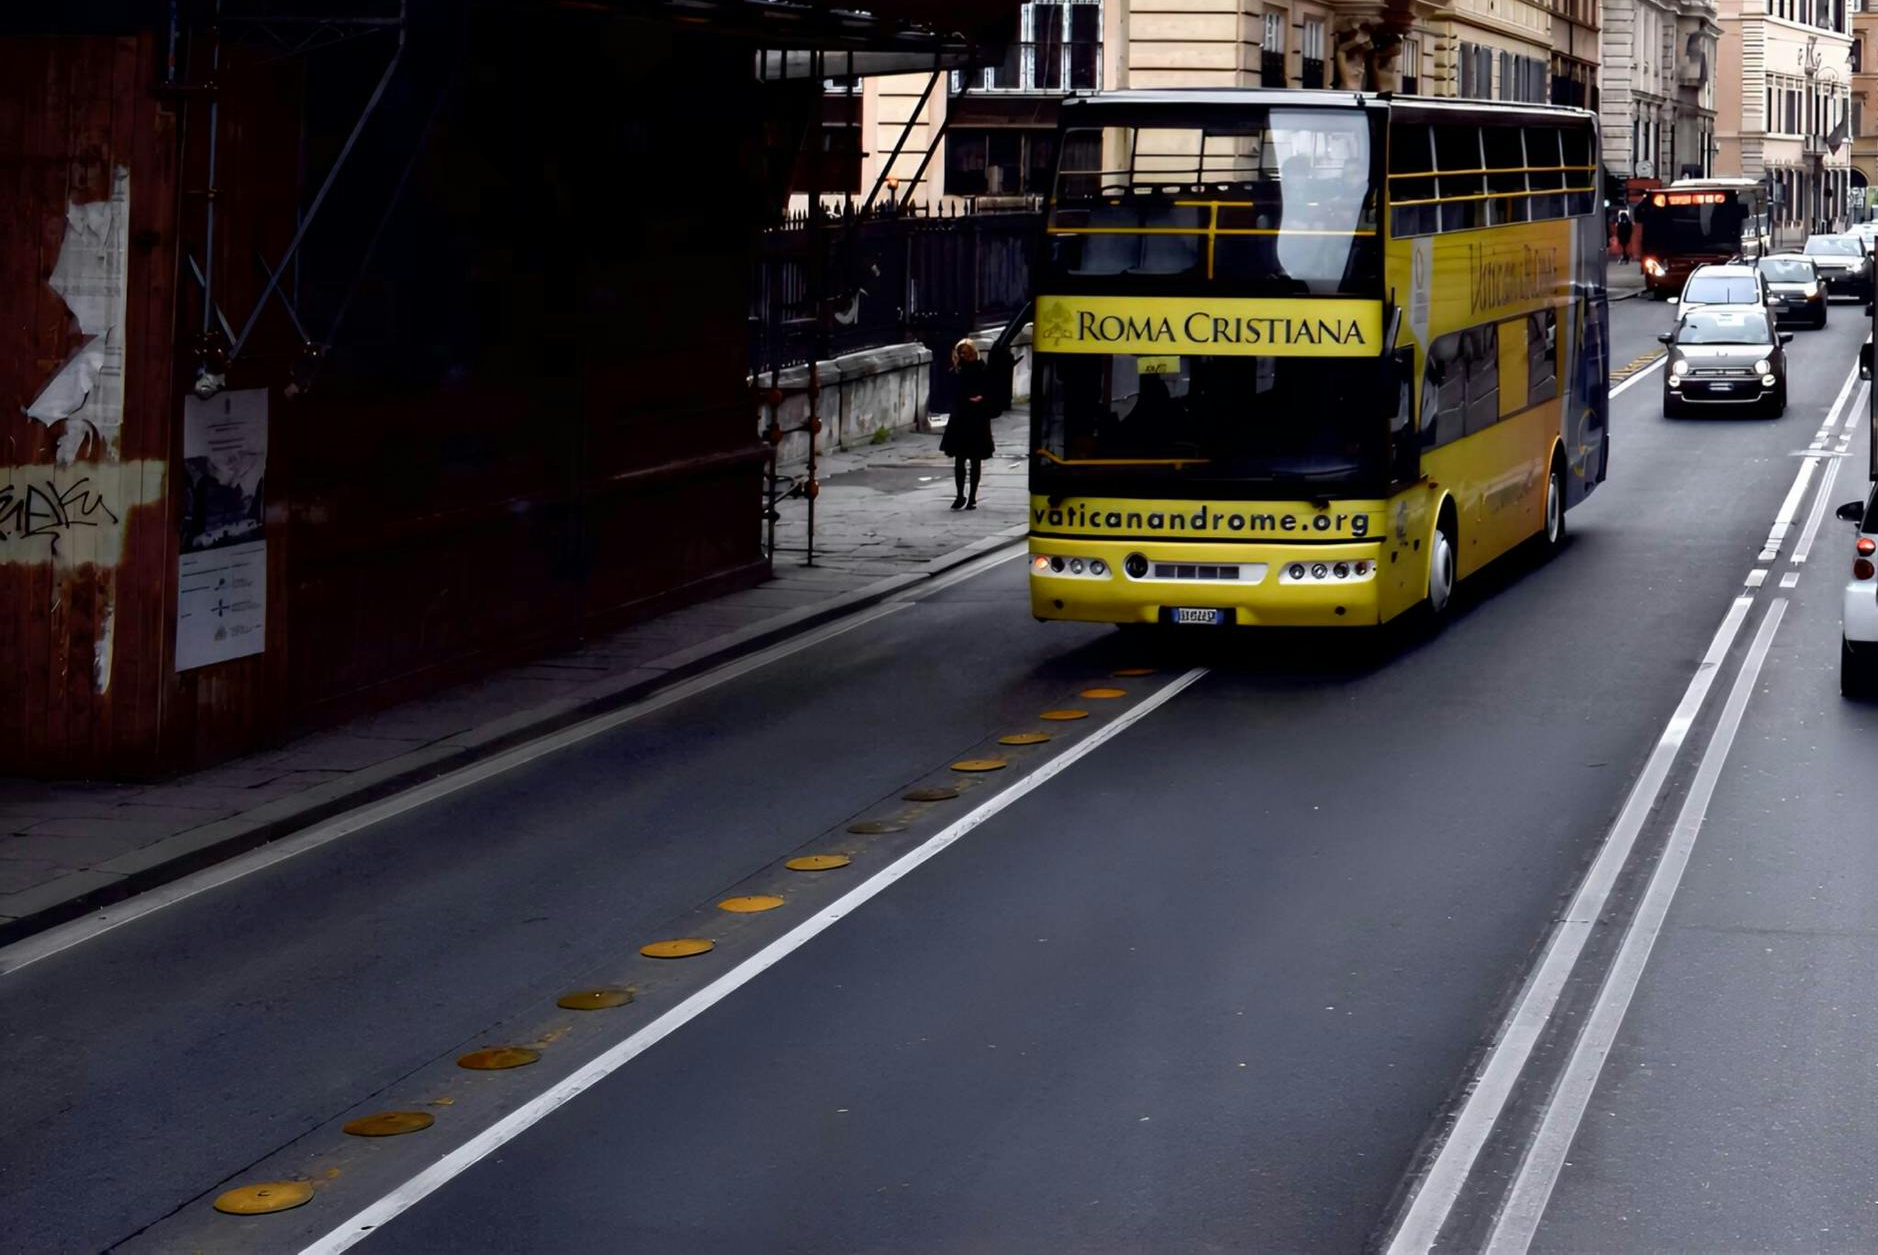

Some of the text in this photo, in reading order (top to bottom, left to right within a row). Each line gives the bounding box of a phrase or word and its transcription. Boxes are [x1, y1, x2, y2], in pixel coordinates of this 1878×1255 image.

[1076, 310, 1366, 346] ROMA CRISTIANA
[1033, 502, 1370, 538] vaticanandrome.org
